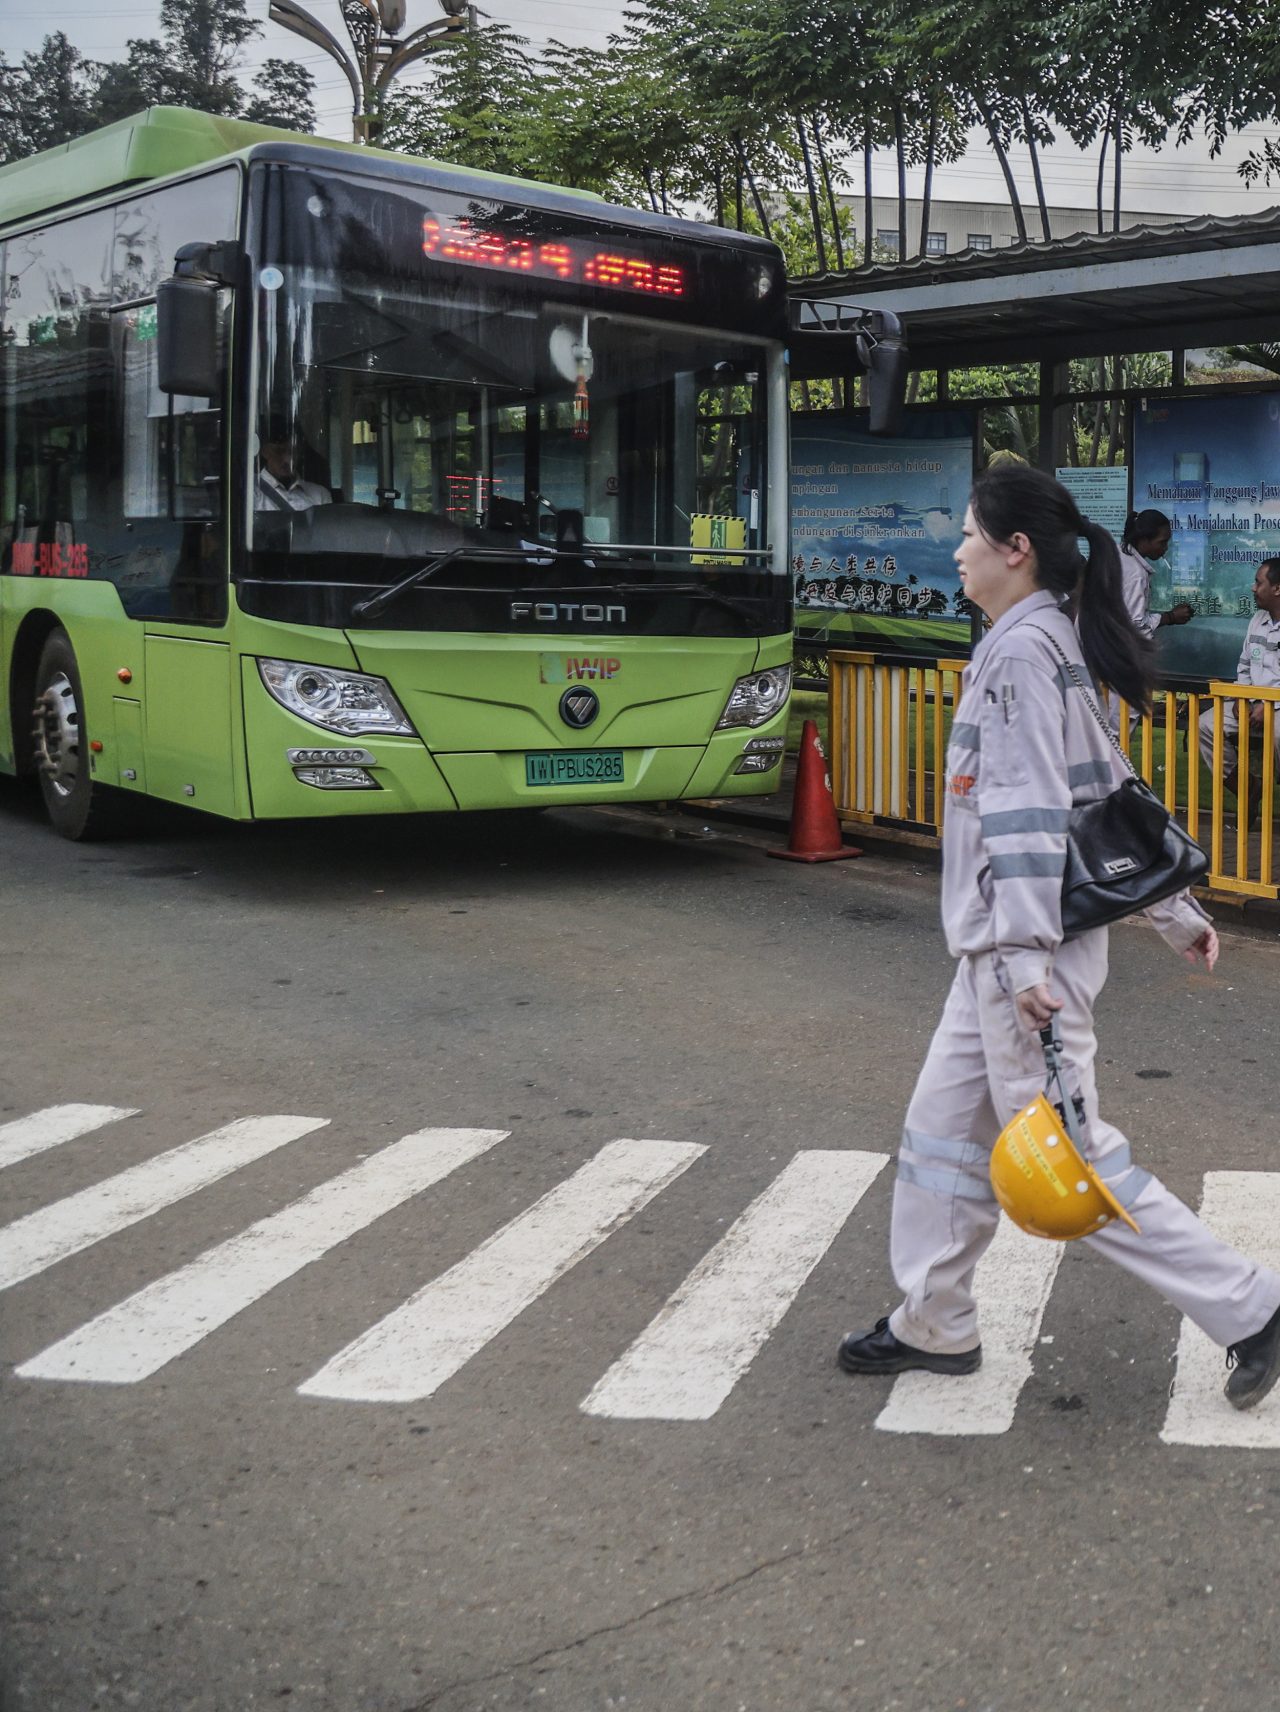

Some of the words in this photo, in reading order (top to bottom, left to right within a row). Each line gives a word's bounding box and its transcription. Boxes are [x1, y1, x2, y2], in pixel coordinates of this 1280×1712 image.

[829, 461, 849, 473] dan
[853, 461, 901, 473] manusia
[906, 459, 942, 474] hidup
[1147, 482, 1202, 500] Memahami
[1206, 482, 1257, 502] Tanggung
[860, 506, 895, 518] serta
[843, 526, 926, 538] disinkronkan
[1187, 513, 1250, 534] Menjalankan
[511, 602, 627, 622] FOTON
[567, 658, 621, 679] IWIP
